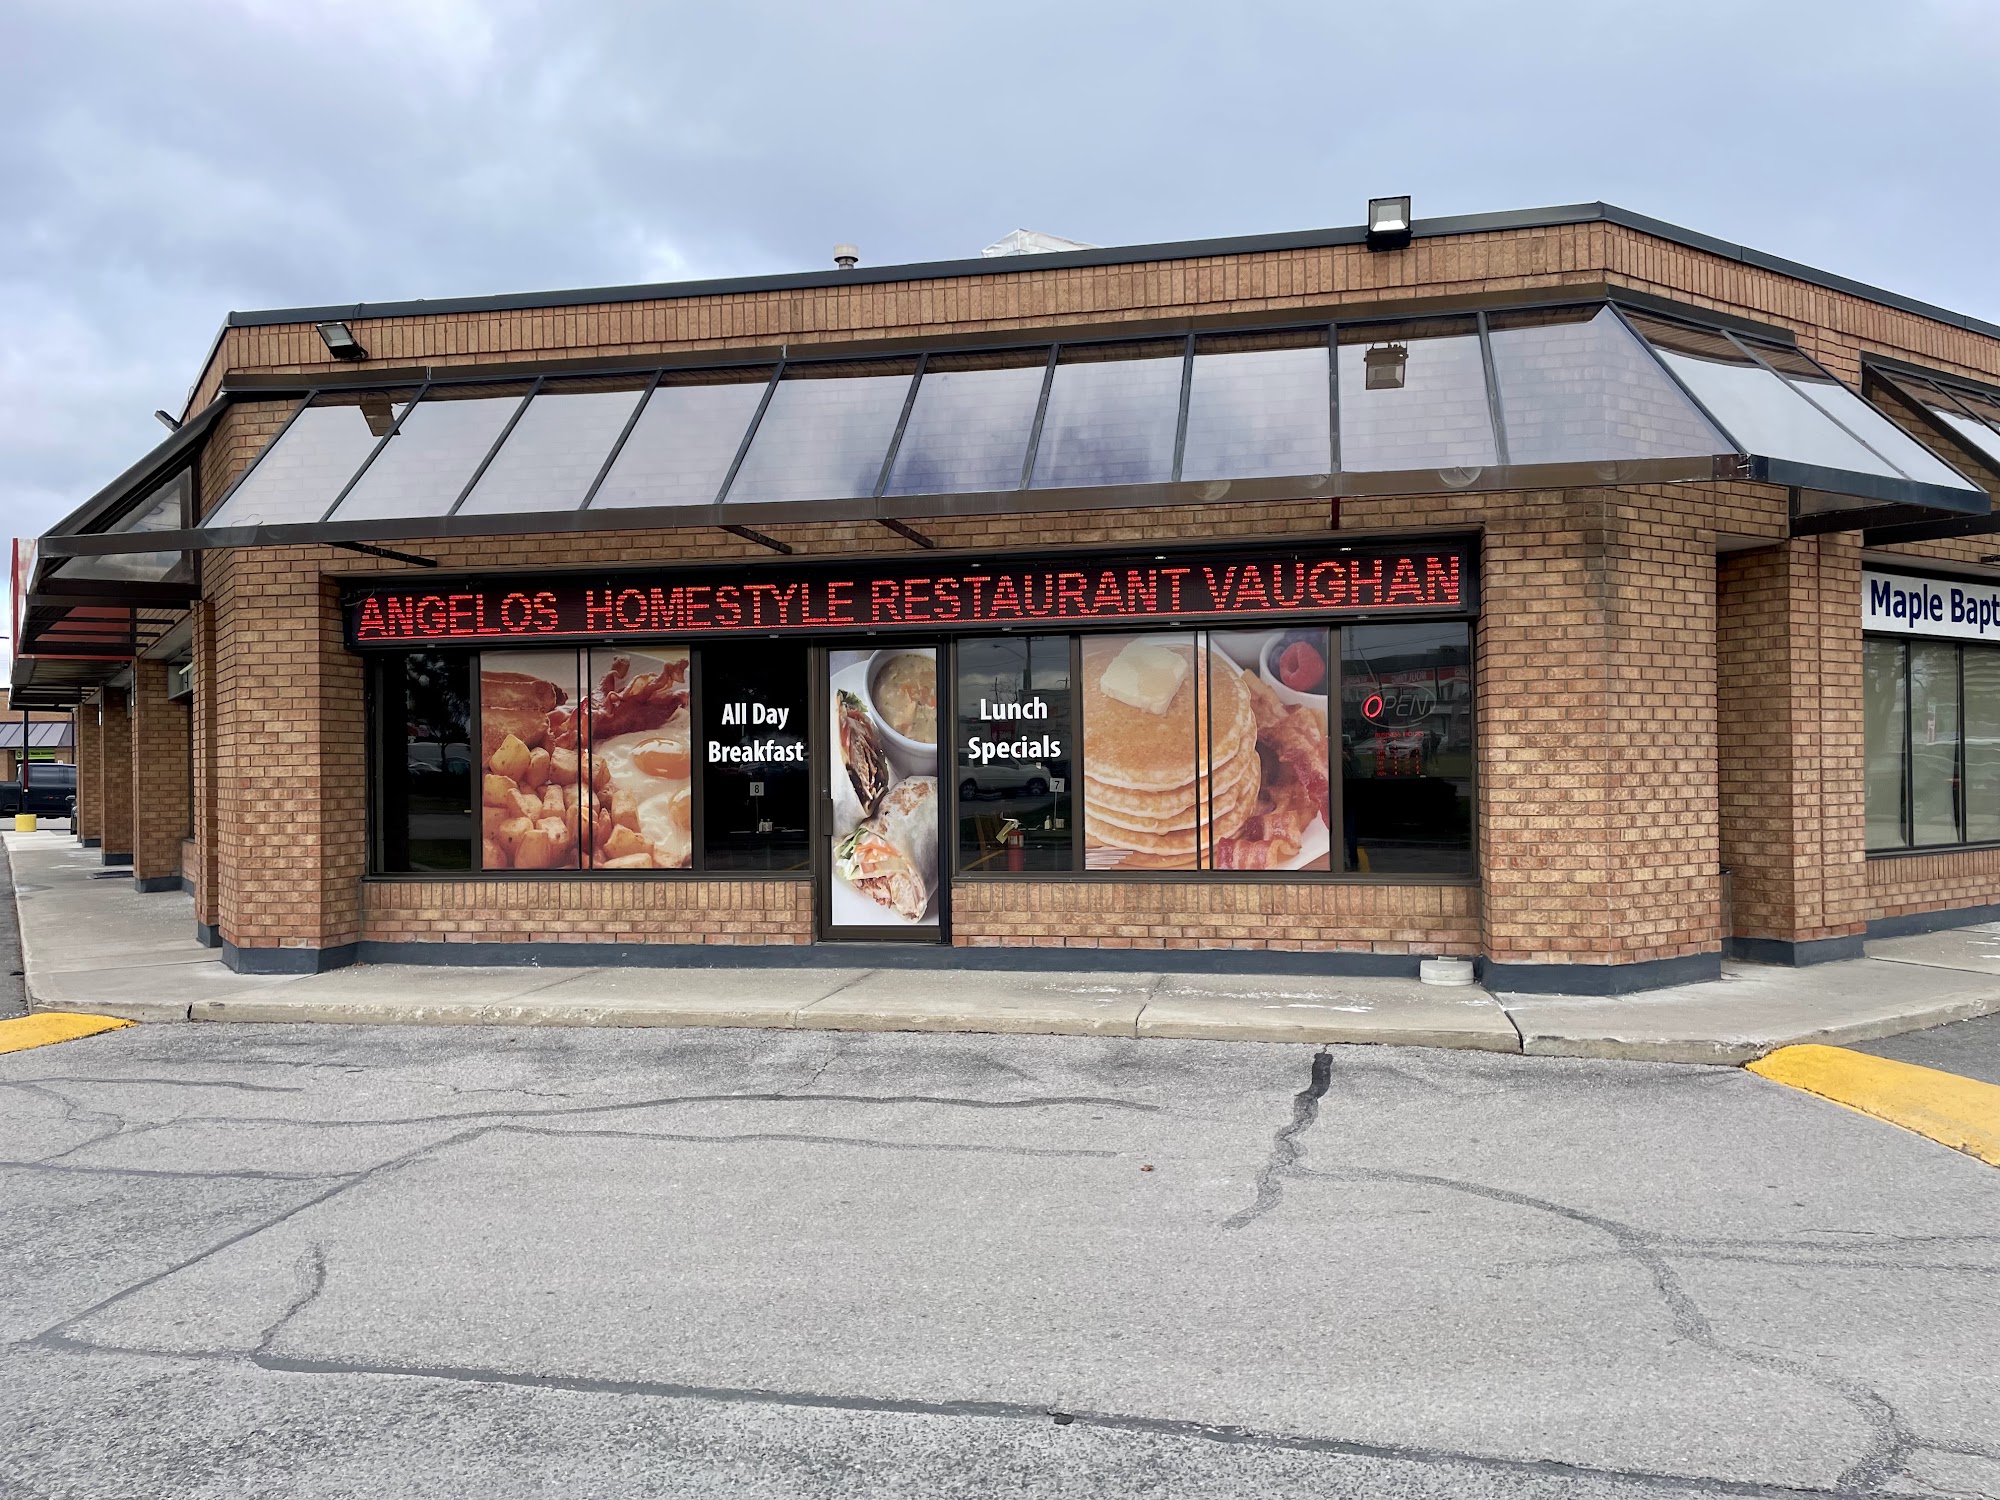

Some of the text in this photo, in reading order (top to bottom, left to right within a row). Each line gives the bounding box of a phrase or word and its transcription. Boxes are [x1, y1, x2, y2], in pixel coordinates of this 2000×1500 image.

[358, 556, 1460, 636] ANGELOS HOMESTYLE RESTAURANT VAUGHAN
[1870, 579, 2000, 633] Maple Bapt
[721, 702, 790, 731] All Day
[980, 696, 1048, 720] Lunch
[1363, 693, 1430, 719] OPEN
[708, 739, 804, 763] Breakfast
[968, 734, 1061, 765] Specials
[754, 784, 760, 794] 8
[1054, 780, 1060, 790] 7
